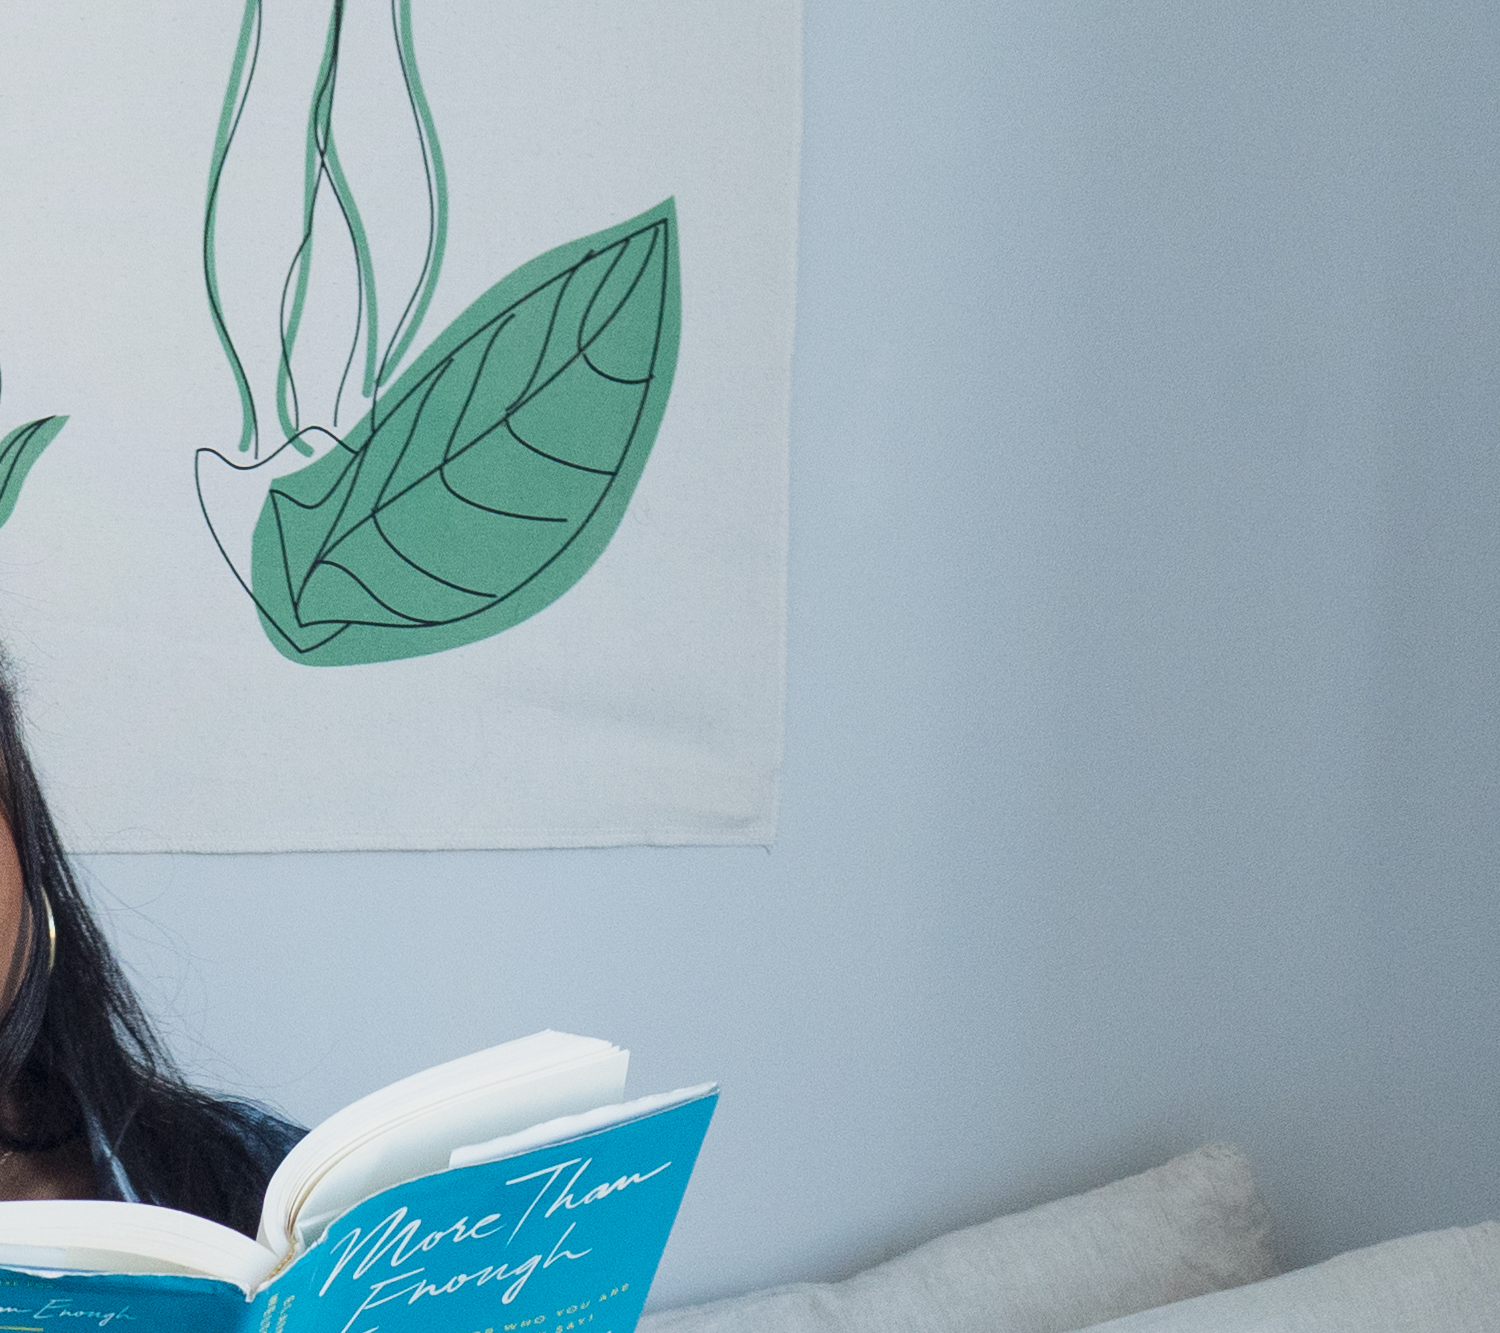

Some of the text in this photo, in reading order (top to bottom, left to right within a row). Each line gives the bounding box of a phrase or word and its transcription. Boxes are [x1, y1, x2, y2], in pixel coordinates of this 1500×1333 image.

[318, 1157, 672, 1298] More Than
[33, 1298, 136, 1326] Enough
[504, 1315, 546, 1331] WHO
[556, 1300, 590, 1317] YOU
[599, 1282, 629, 1302] ARE
